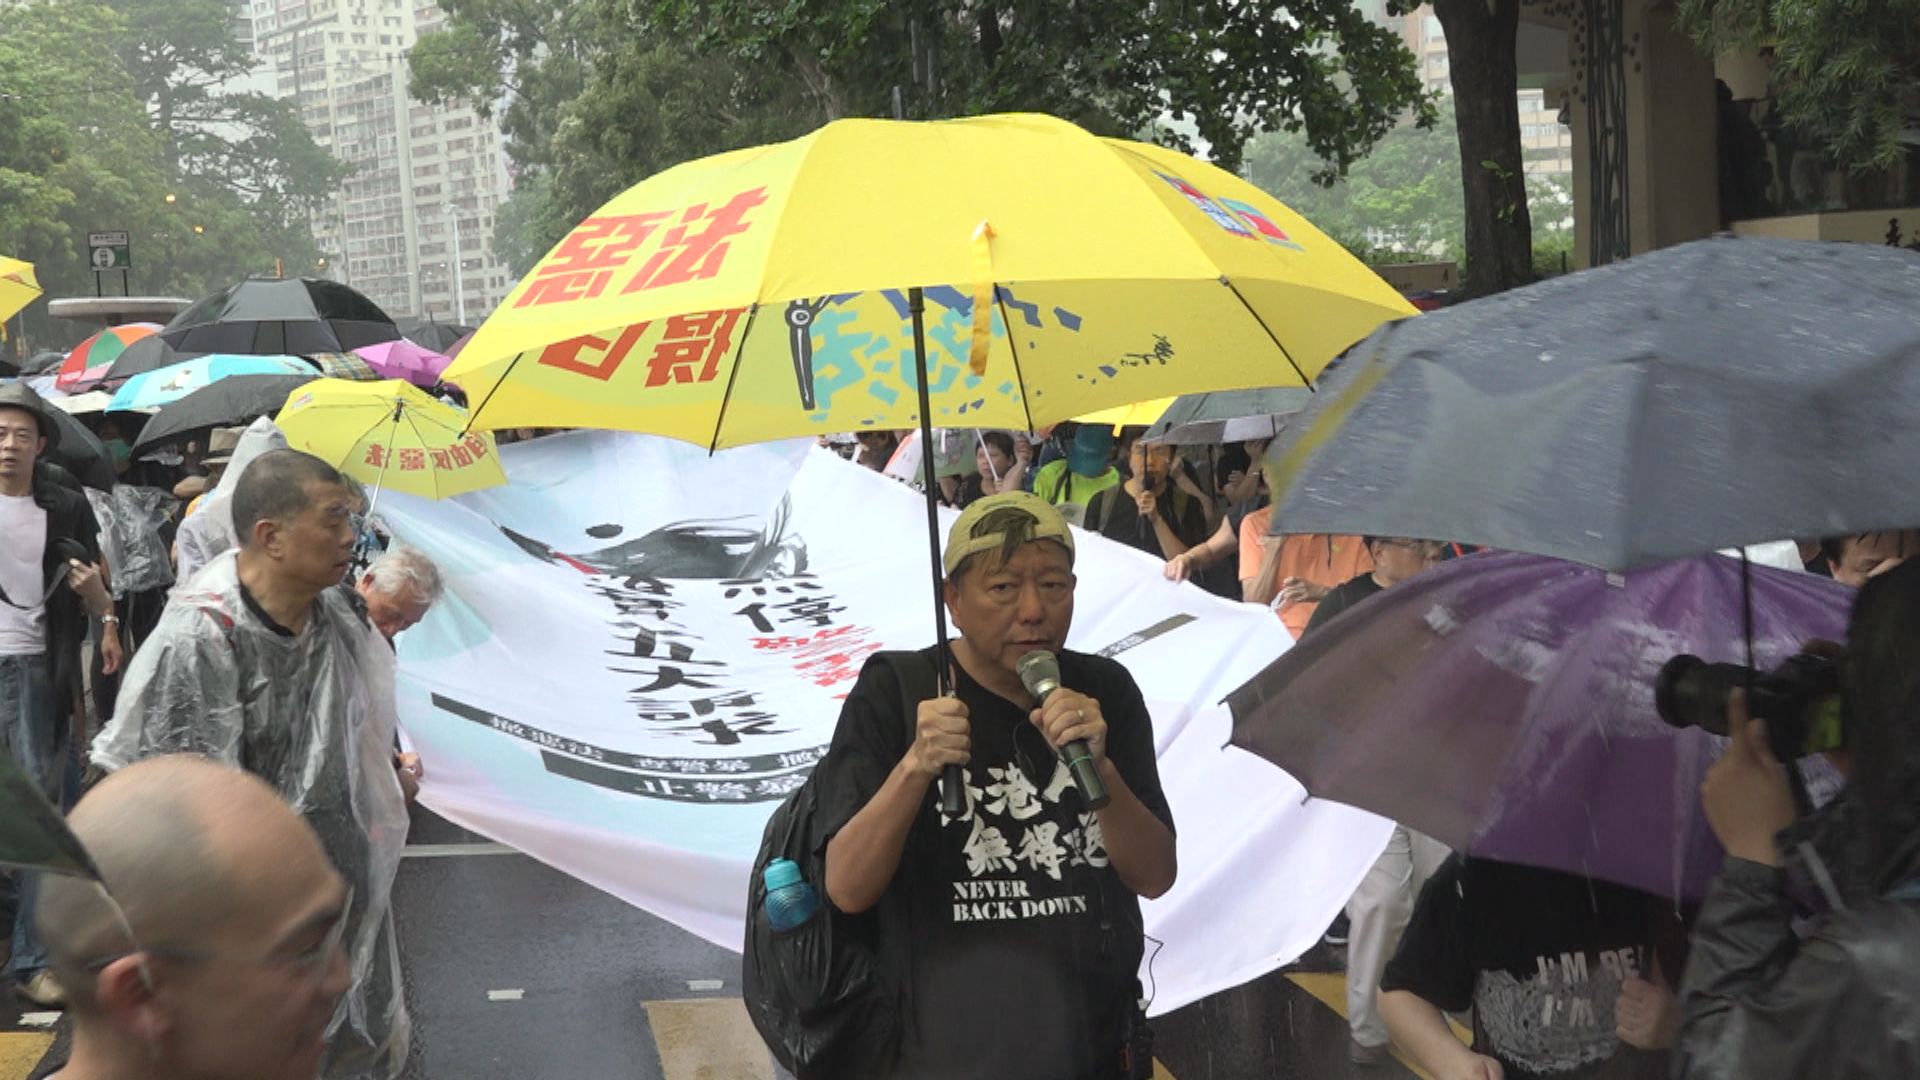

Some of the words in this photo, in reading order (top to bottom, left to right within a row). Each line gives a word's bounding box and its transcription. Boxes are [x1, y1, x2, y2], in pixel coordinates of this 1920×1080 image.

[512, 185, 768, 308] 惡法
[952, 880, 1030, 900] NEVER
[952, 901, 1018, 921] BACK
[1021, 896, 1088, 918] DOWN
[1536, 951, 1589, 985] I'M
[1600, 946, 1645, 980] RE
